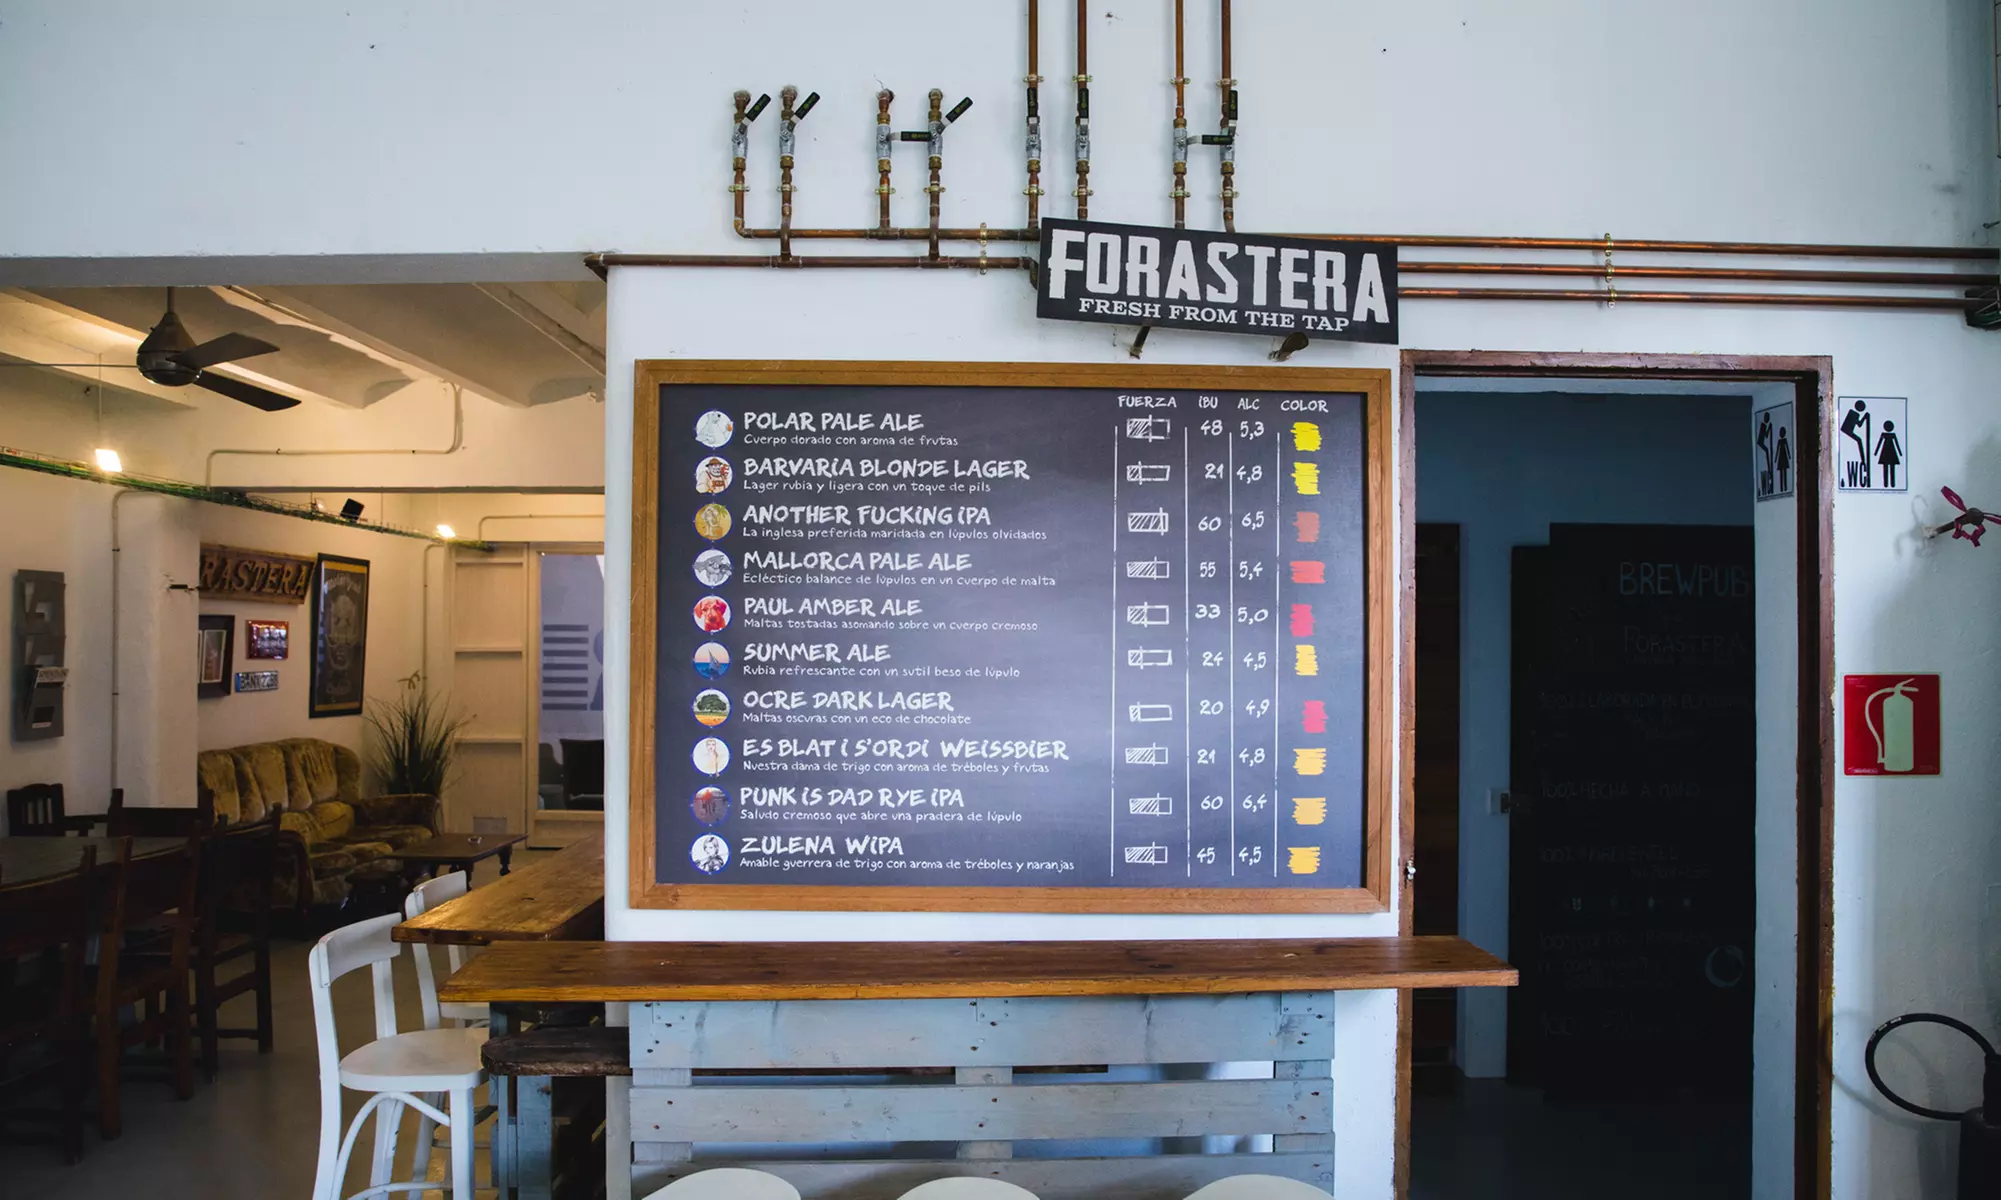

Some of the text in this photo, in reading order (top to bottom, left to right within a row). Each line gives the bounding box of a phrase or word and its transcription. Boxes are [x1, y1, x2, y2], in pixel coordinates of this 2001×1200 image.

[1048, 228, 1390, 324] FORASTERA
[1078, 298, 1350, 332] FRESH FROM THE TAP
[1118, 395, 1177, 408] FUERZA
[1237, 398, 1260, 410] ALC
[1281, 400, 1328, 413] COLOR
[744, 412, 924, 432] POLAR PALE ALE
[1200, 419, 1223, 436] 48
[1240, 421, 1264, 439] 5,3
[744, 434, 958, 446] Cuerpo dorado con aroma de frutas
[859, 458, 949, 478] BLONDE
[954, 460, 1030, 480] LAGER
[1236, 465, 1262, 484] 4,8
[1847, 461, 1867, 488] WC
[744, 480, 991, 495] Lager rubia y ligera con un toque de pils
[743, 504, 851, 525] ANOTHER
[1198, 516, 1221, 531] 60
[1242, 511, 1264, 530] 6,5
[743, 527, 757, 536] La
[762, 527, 804, 540] inglesa
[808, 527, 867, 540] preferida
[871, 529, 925, 538] maridada
[993, 530, 1047, 539] olvidados
[743, 551, 972, 572] MALLORCA PALE ALE
[1200, 562, 1216, 577] 55
[1240, 561, 1263, 580] 5,4
[806, 574, 852, 584] balance
[856, 575, 871, 584] de
[957, 577, 997, 587] cuerpo
[1002, 576, 1016, 585] de
[1021, 576, 1055, 585] malta
[1619, 561, 1749, 598] BREWPUB
[744, 597, 923, 617] PAUL AMBER ALE
[1195, 604, 1220, 619] 33
[1238, 607, 1268, 624] 5,0
[744, 618, 783, 628] Maltas
[787, 619, 838, 628] tostadas
[842, 620, 894, 629] asomando
[899, 620, 928, 629] sobre
[950, 622, 988, 632] cuerpo
[744, 643, 891, 663] SUMMER ALE
[1244, 652, 1266, 671] 4,5
[743, 665, 775, 675] Rubia
[780, 665, 855, 675] refrescante
[860, 668, 880, 676] con
[903, 666, 930, 676] sutil
[935, 667, 961, 676] beso
[965, 668, 980, 676] de
[743, 690, 954, 711] OCRE DARK LAGER
[1200, 700, 1223, 715] 20
[1246, 700, 1270, 718] 4,9
[743, 712, 782, 722] Maltas
[786, 715, 827, 723] oscuras
[831, 715, 851, 723] con
[872, 715, 891, 723] eco
[895, 714, 910, 723] de
[914, 714, 971, 724] chocolate
[743, 739, 773, 756] ES
[777, 739, 836, 757] BLAT
[1239, 748, 1265, 766] 4,8
[743, 760, 788, 770] Nuestra
[791, 761, 820, 770] dama
[823, 762, 837, 771] de
[841, 761, 870, 774] trigo
[933, 763, 947, 771] de
[1002, 765, 1009, 775] y
[1013, 762, 1049, 772] frutas
[740, 787, 797, 807] PUNK
[827, 788, 873, 806] DAD
[878, 788, 926, 808] RYE
[1201, 795, 1223, 810] 60
[1243, 794, 1267, 812] 6,4
[740, 808, 779, 820] Saludo
[783, 812, 832, 820] cremoso
[836, 813, 856, 824] que
[861, 810, 887, 820] abre
[916, 812, 963, 823] pradera
[967, 812, 982, 821] de
[740, 836, 835, 855] ZULENA
[1197, 847, 1215, 864] 45
[1239, 846, 1261, 866] 4,5
[740, 857, 779, 867] Amable
[783, 860, 832, 871] guerrera
[835, 858, 850, 868] de
[854, 858, 883, 871] trigo
[886, 860, 906, 868] con
[910, 861, 943, 869] aroma
[946, 860, 961, 869] de
[1016, 862, 1024, 872] y
[1027, 860, 1074, 873] naranjas
